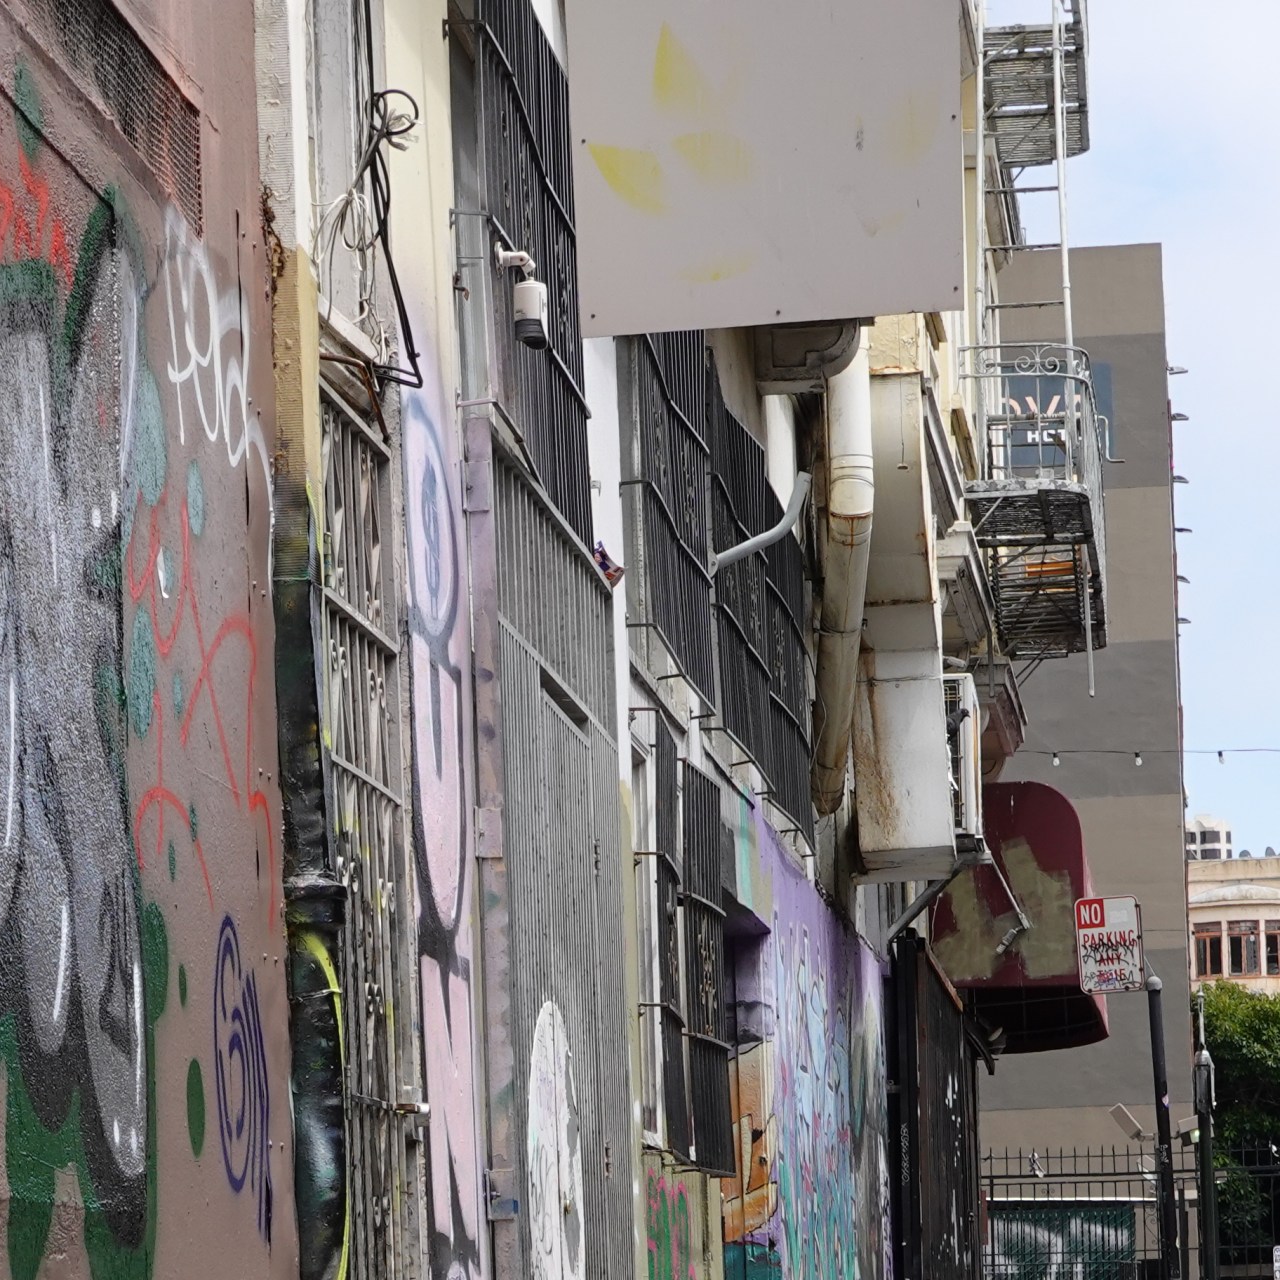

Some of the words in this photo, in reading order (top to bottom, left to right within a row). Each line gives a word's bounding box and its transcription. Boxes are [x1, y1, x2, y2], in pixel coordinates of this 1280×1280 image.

[1080, 903, 1101, 926] NO
[1083, 930, 1136, 947] PARKING
[1099, 952, 1122, 966] ANY
